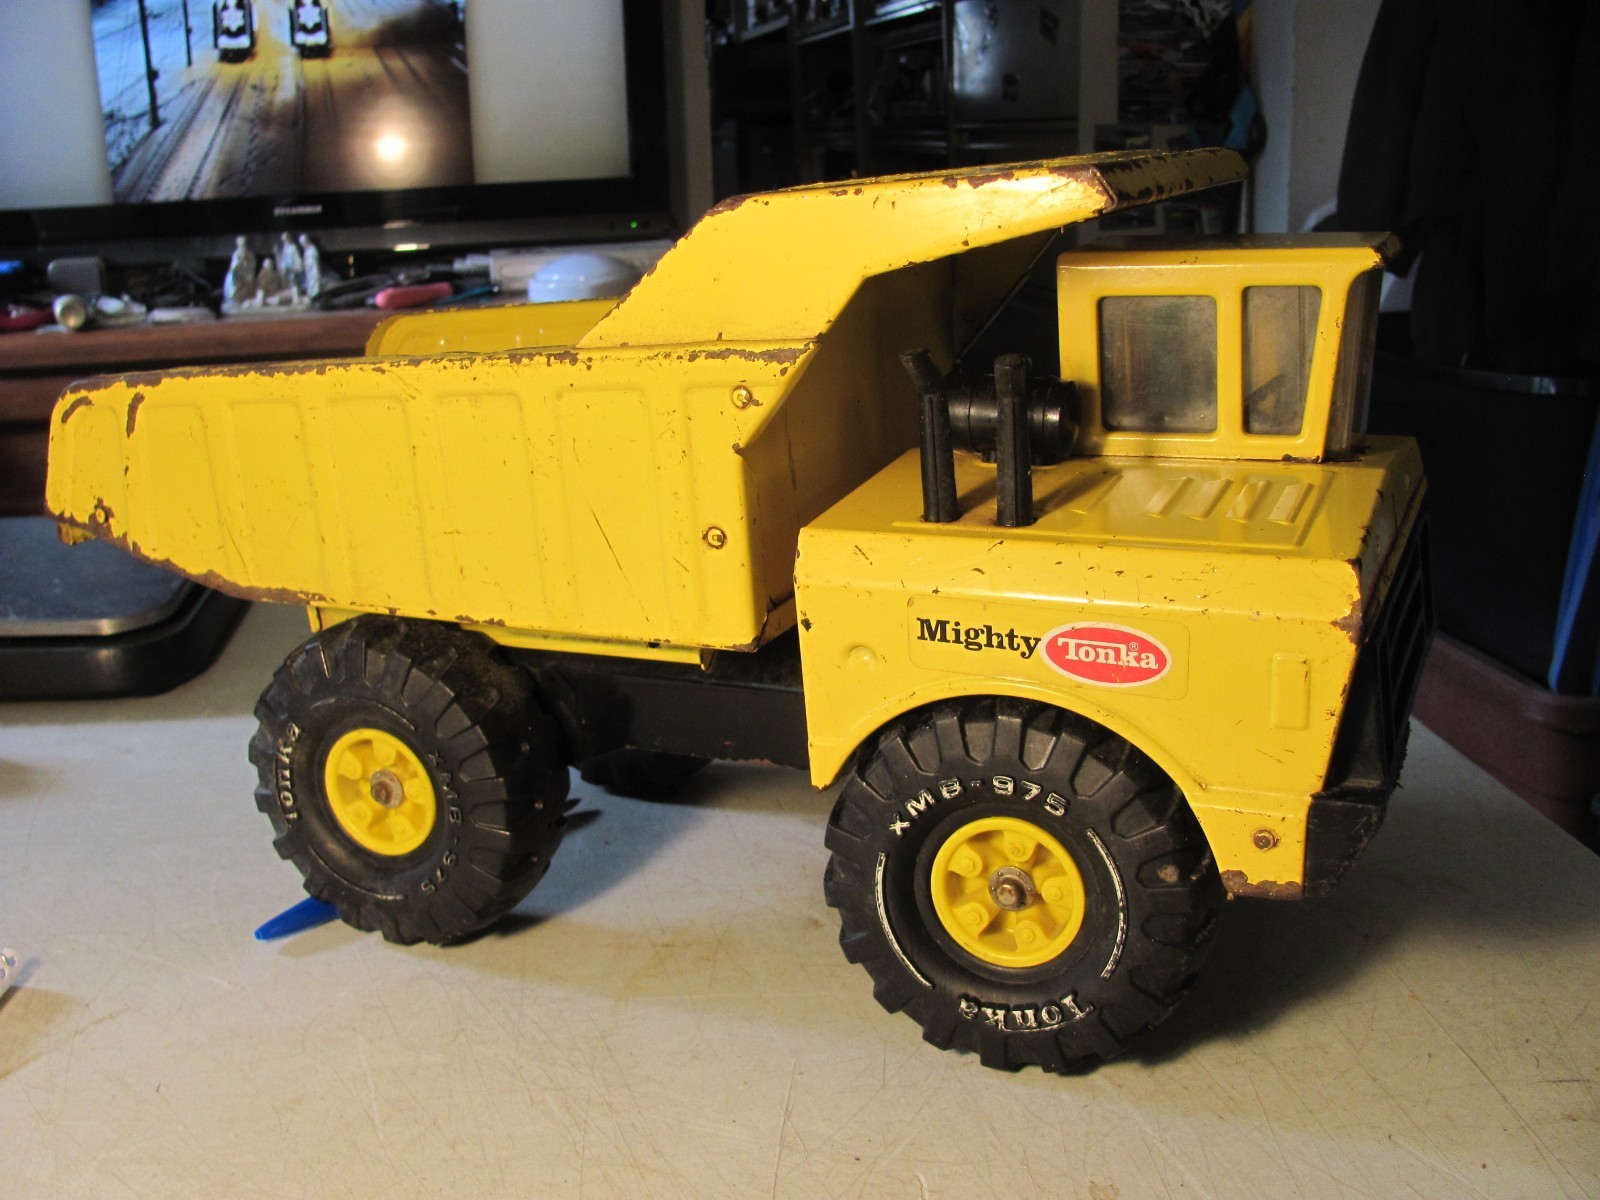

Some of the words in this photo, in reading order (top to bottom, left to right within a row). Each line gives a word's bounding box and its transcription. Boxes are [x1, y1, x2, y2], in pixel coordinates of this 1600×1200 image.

[916, 617, 1041, 660] Mighty
[1057, 637, 1159, 670] Tonka
[888, 775, 1067, 837] XMB-975
[958, 998, 1096, 1032] Tonka
